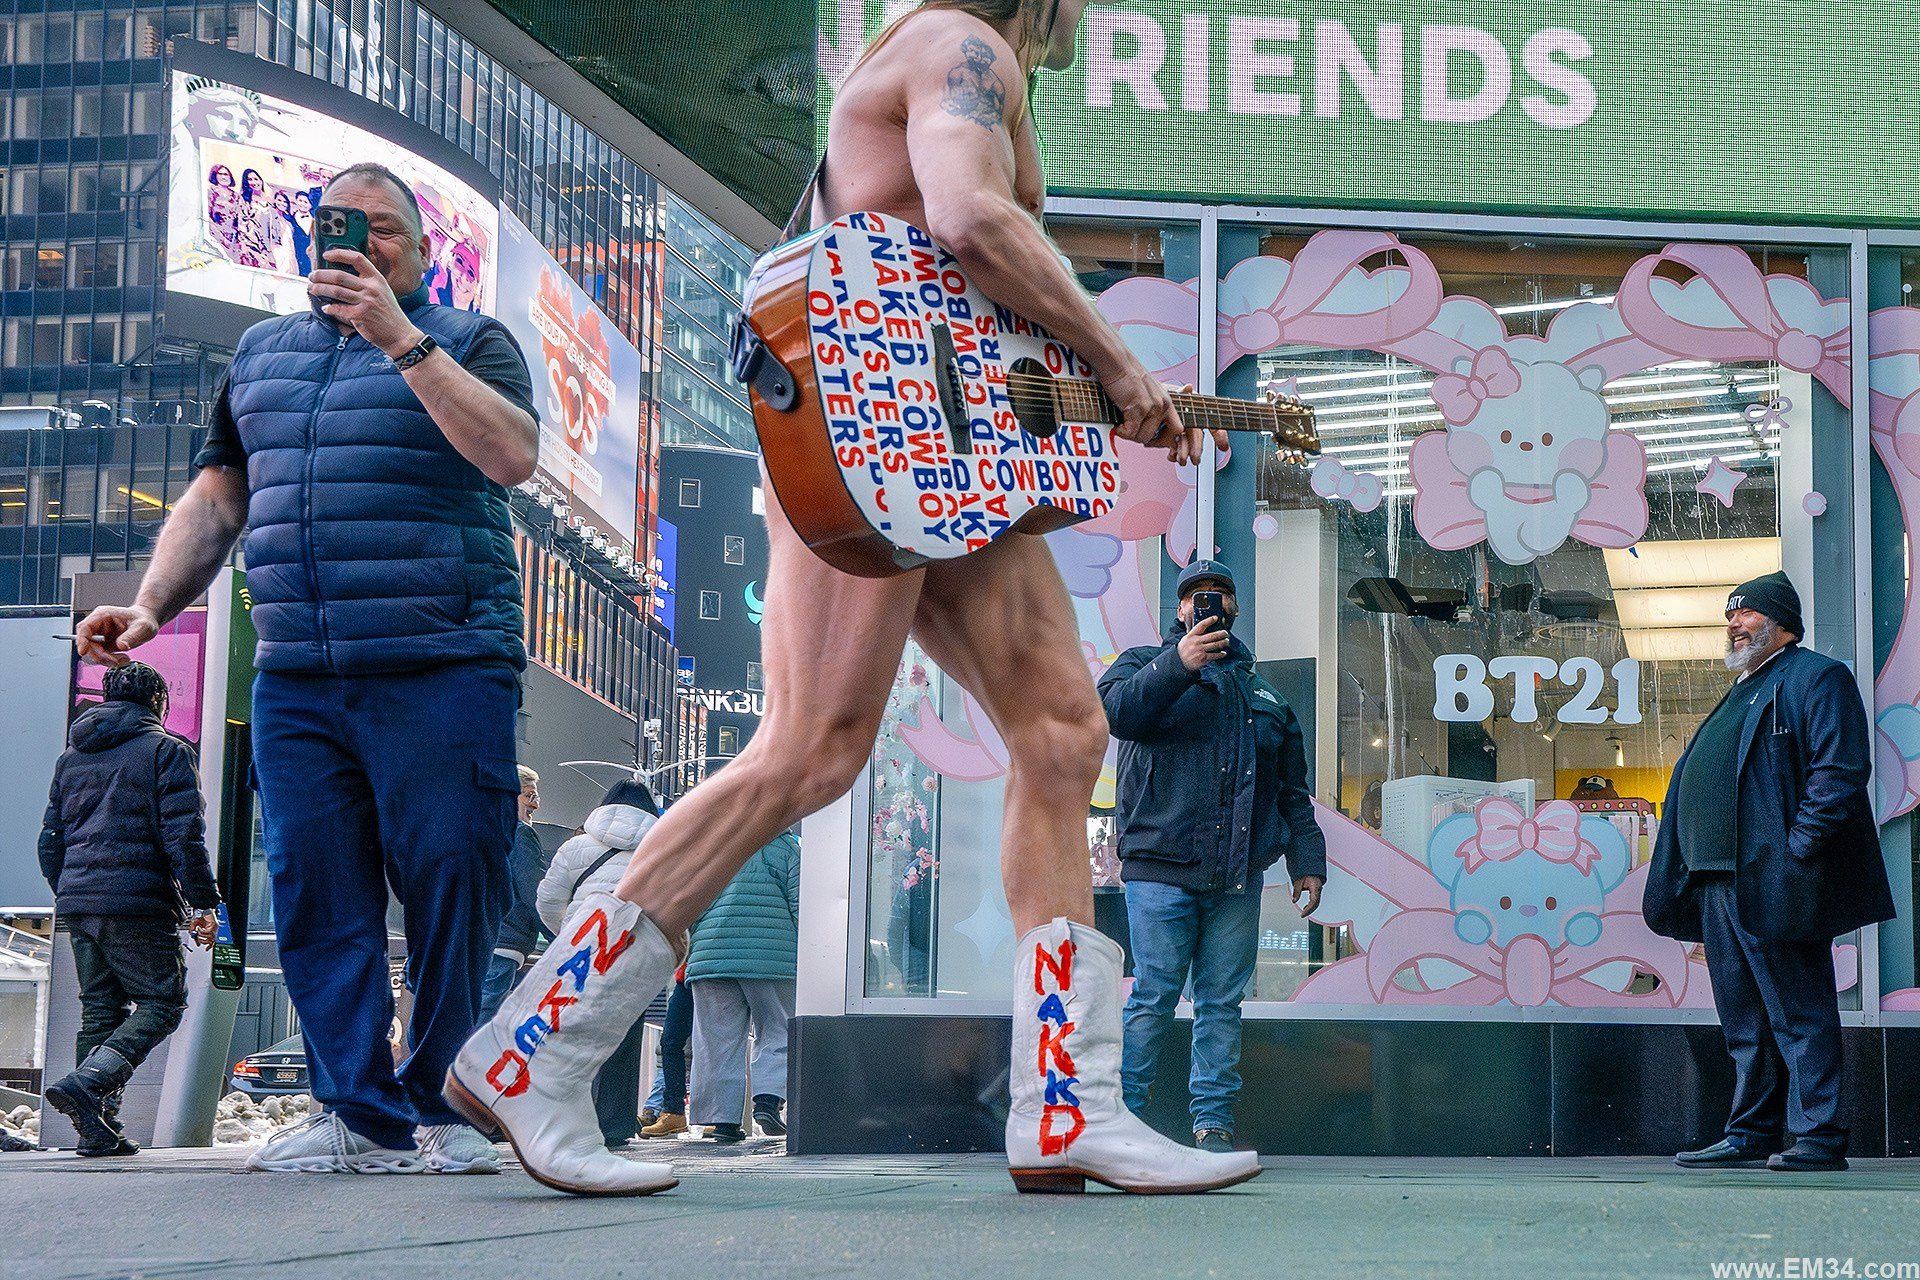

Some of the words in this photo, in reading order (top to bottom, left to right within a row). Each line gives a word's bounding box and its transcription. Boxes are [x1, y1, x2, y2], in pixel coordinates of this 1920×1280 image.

[1086, 9, 1597, 129] RIENDS
[547, 357, 598, 455] SOS
[809, 290, 864, 468] OYSTERS
[854, 299, 908, 473] OYSTERS
[976, 315, 1020, 454] YSTERS
[898, 379, 950, 543] COWBOY
[1432, 654, 1642, 724] BT21
[485, 908, 636, 1098] NAKED
